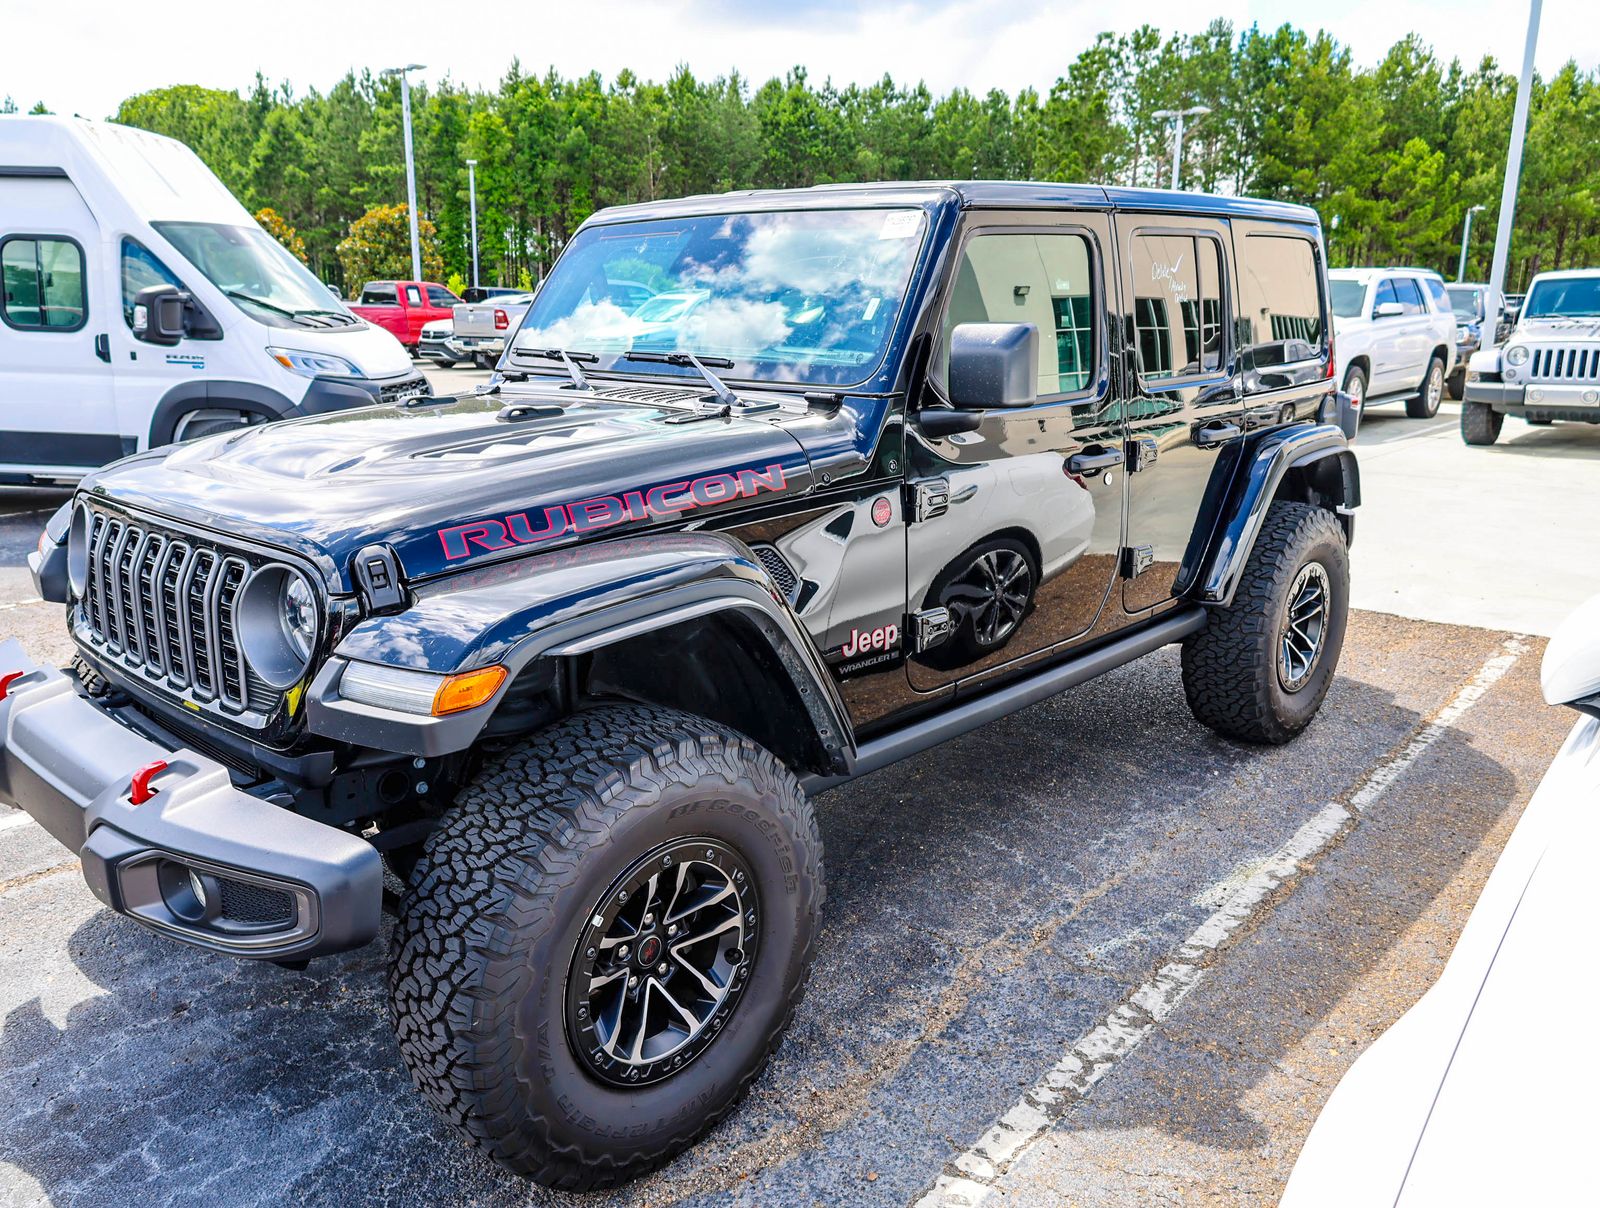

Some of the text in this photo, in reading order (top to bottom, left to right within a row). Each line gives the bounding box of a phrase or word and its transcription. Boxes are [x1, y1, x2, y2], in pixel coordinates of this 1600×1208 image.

[437, 464, 787, 560] RUBICON
[842, 624, 897, 657] Jeep
[839, 655, 890, 675] WRANGLER
